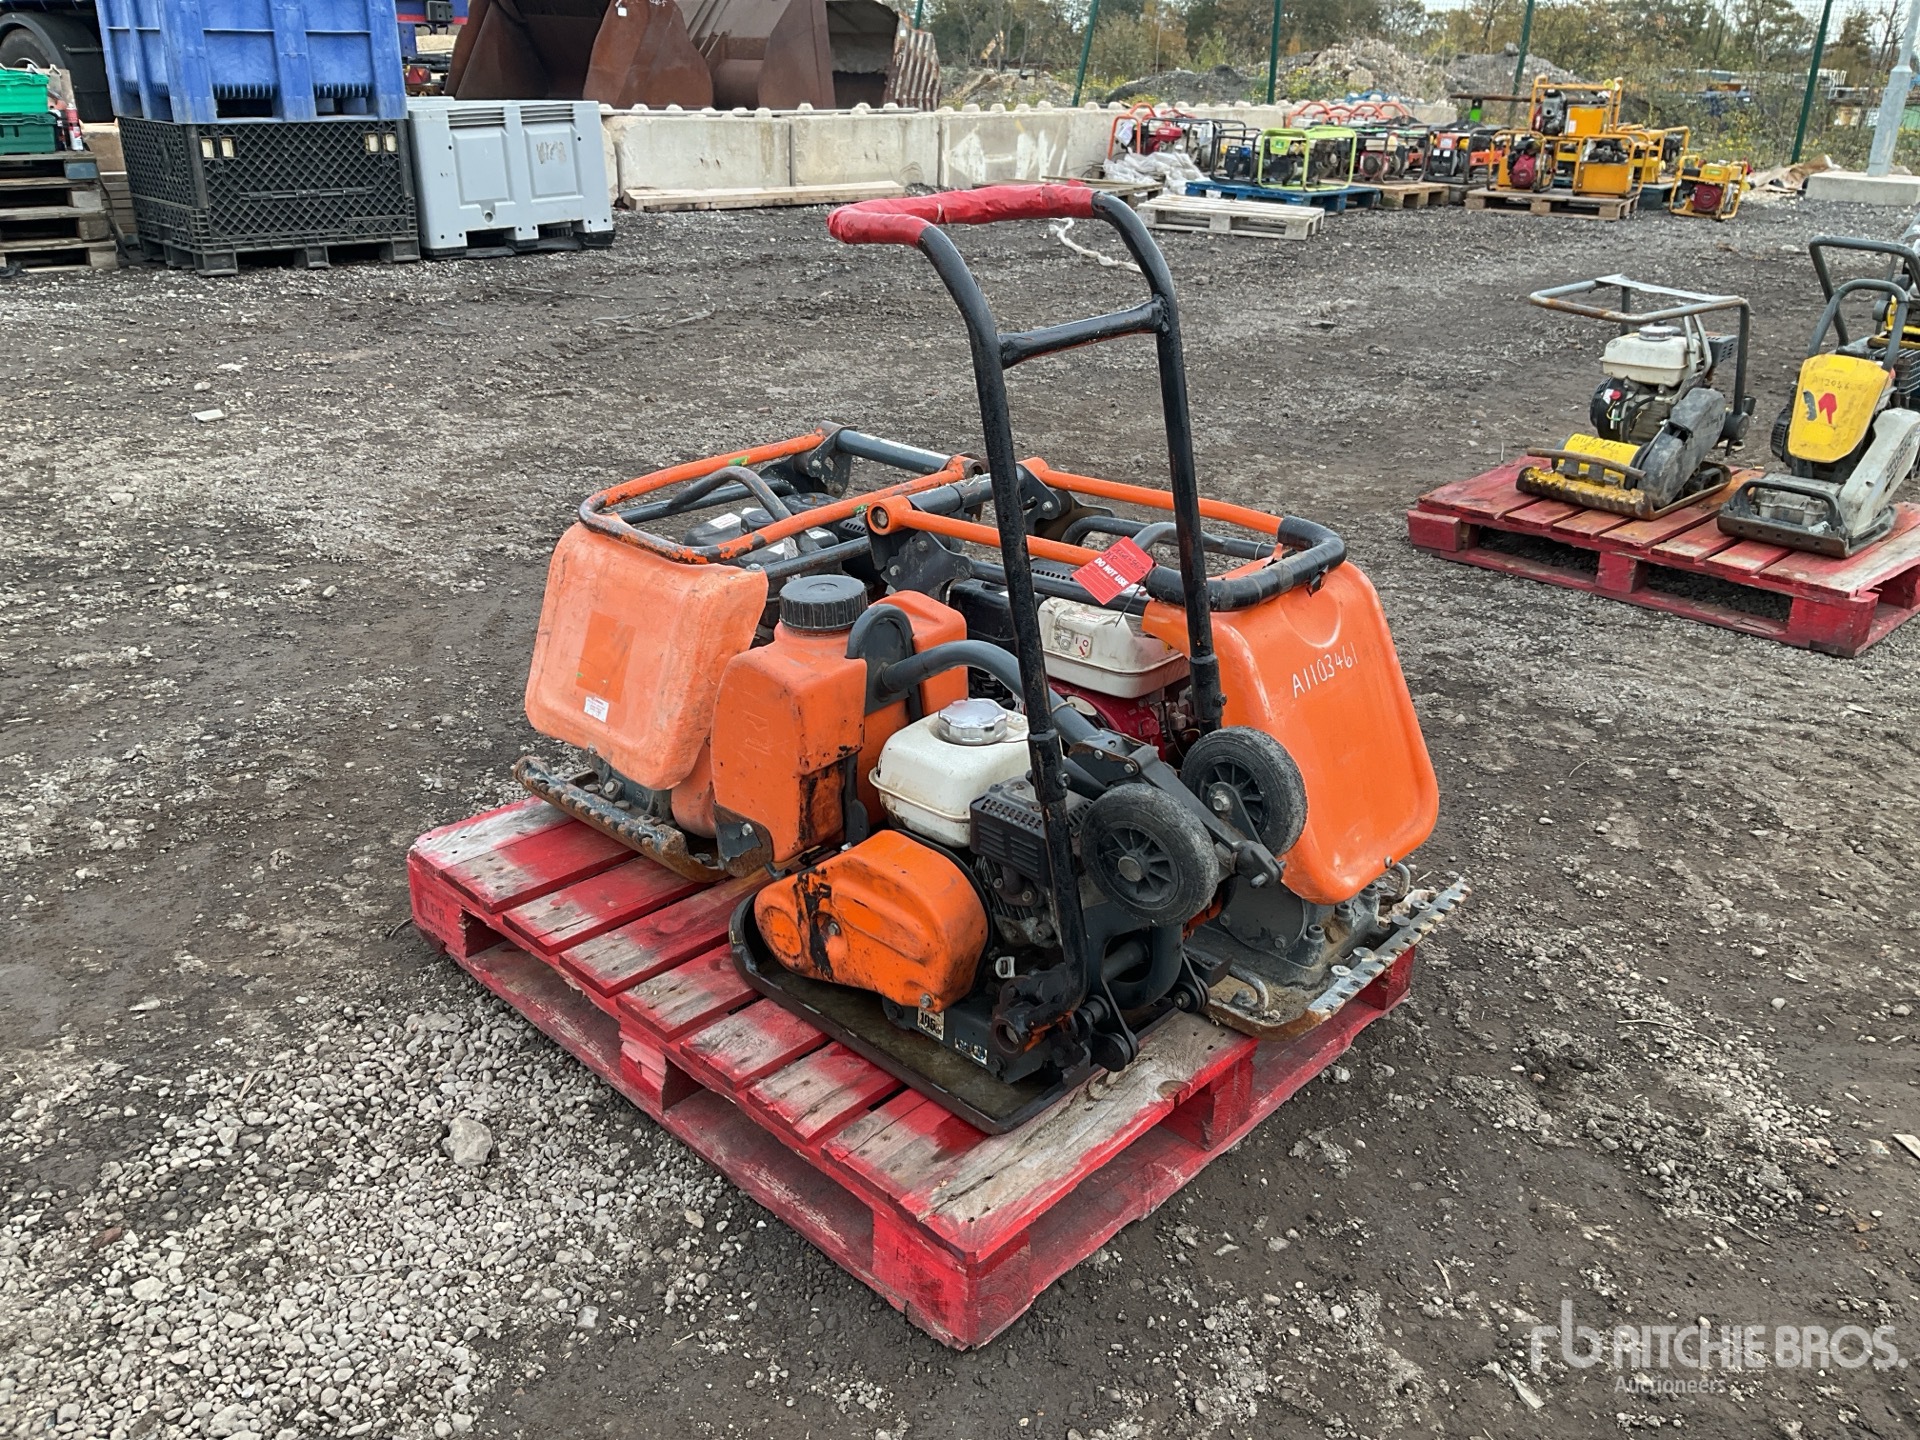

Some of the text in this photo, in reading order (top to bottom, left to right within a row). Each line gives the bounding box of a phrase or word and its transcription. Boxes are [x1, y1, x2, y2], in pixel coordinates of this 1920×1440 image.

[1093, 557, 1107, 567] DO
[1102, 564, 1118, 577] NOT
[1113, 574, 1130, 588] USE
[1292, 641, 1359, 699] A1103461
